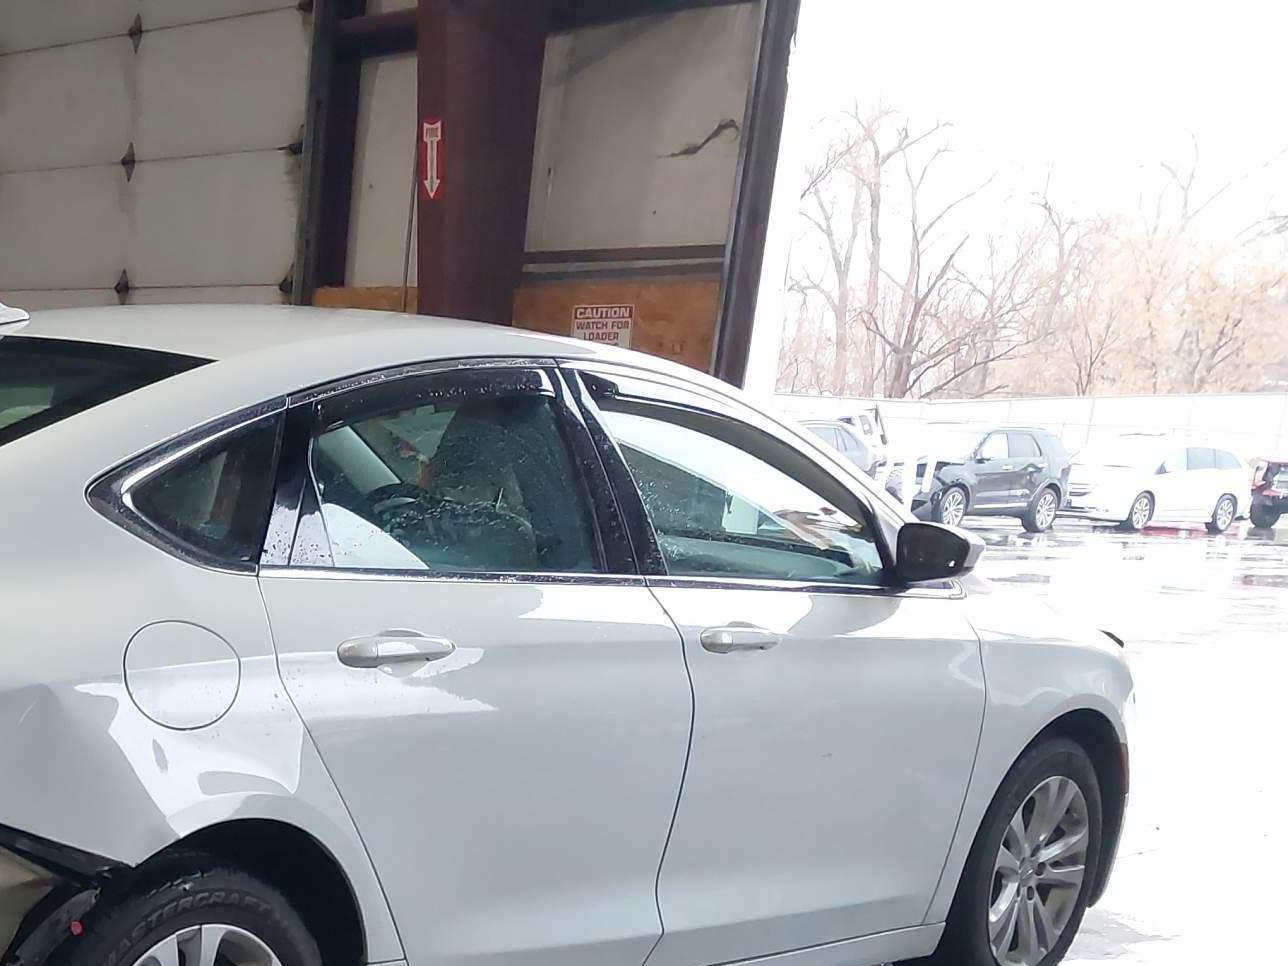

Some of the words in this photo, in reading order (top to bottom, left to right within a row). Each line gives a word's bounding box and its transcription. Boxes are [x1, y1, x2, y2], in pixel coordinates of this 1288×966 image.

[576, 307, 630, 318] CAUTION
[575, 320, 608, 330] WATCH
[611, 320, 630, 330] FOR
[583, 331, 619, 341] LOADER
